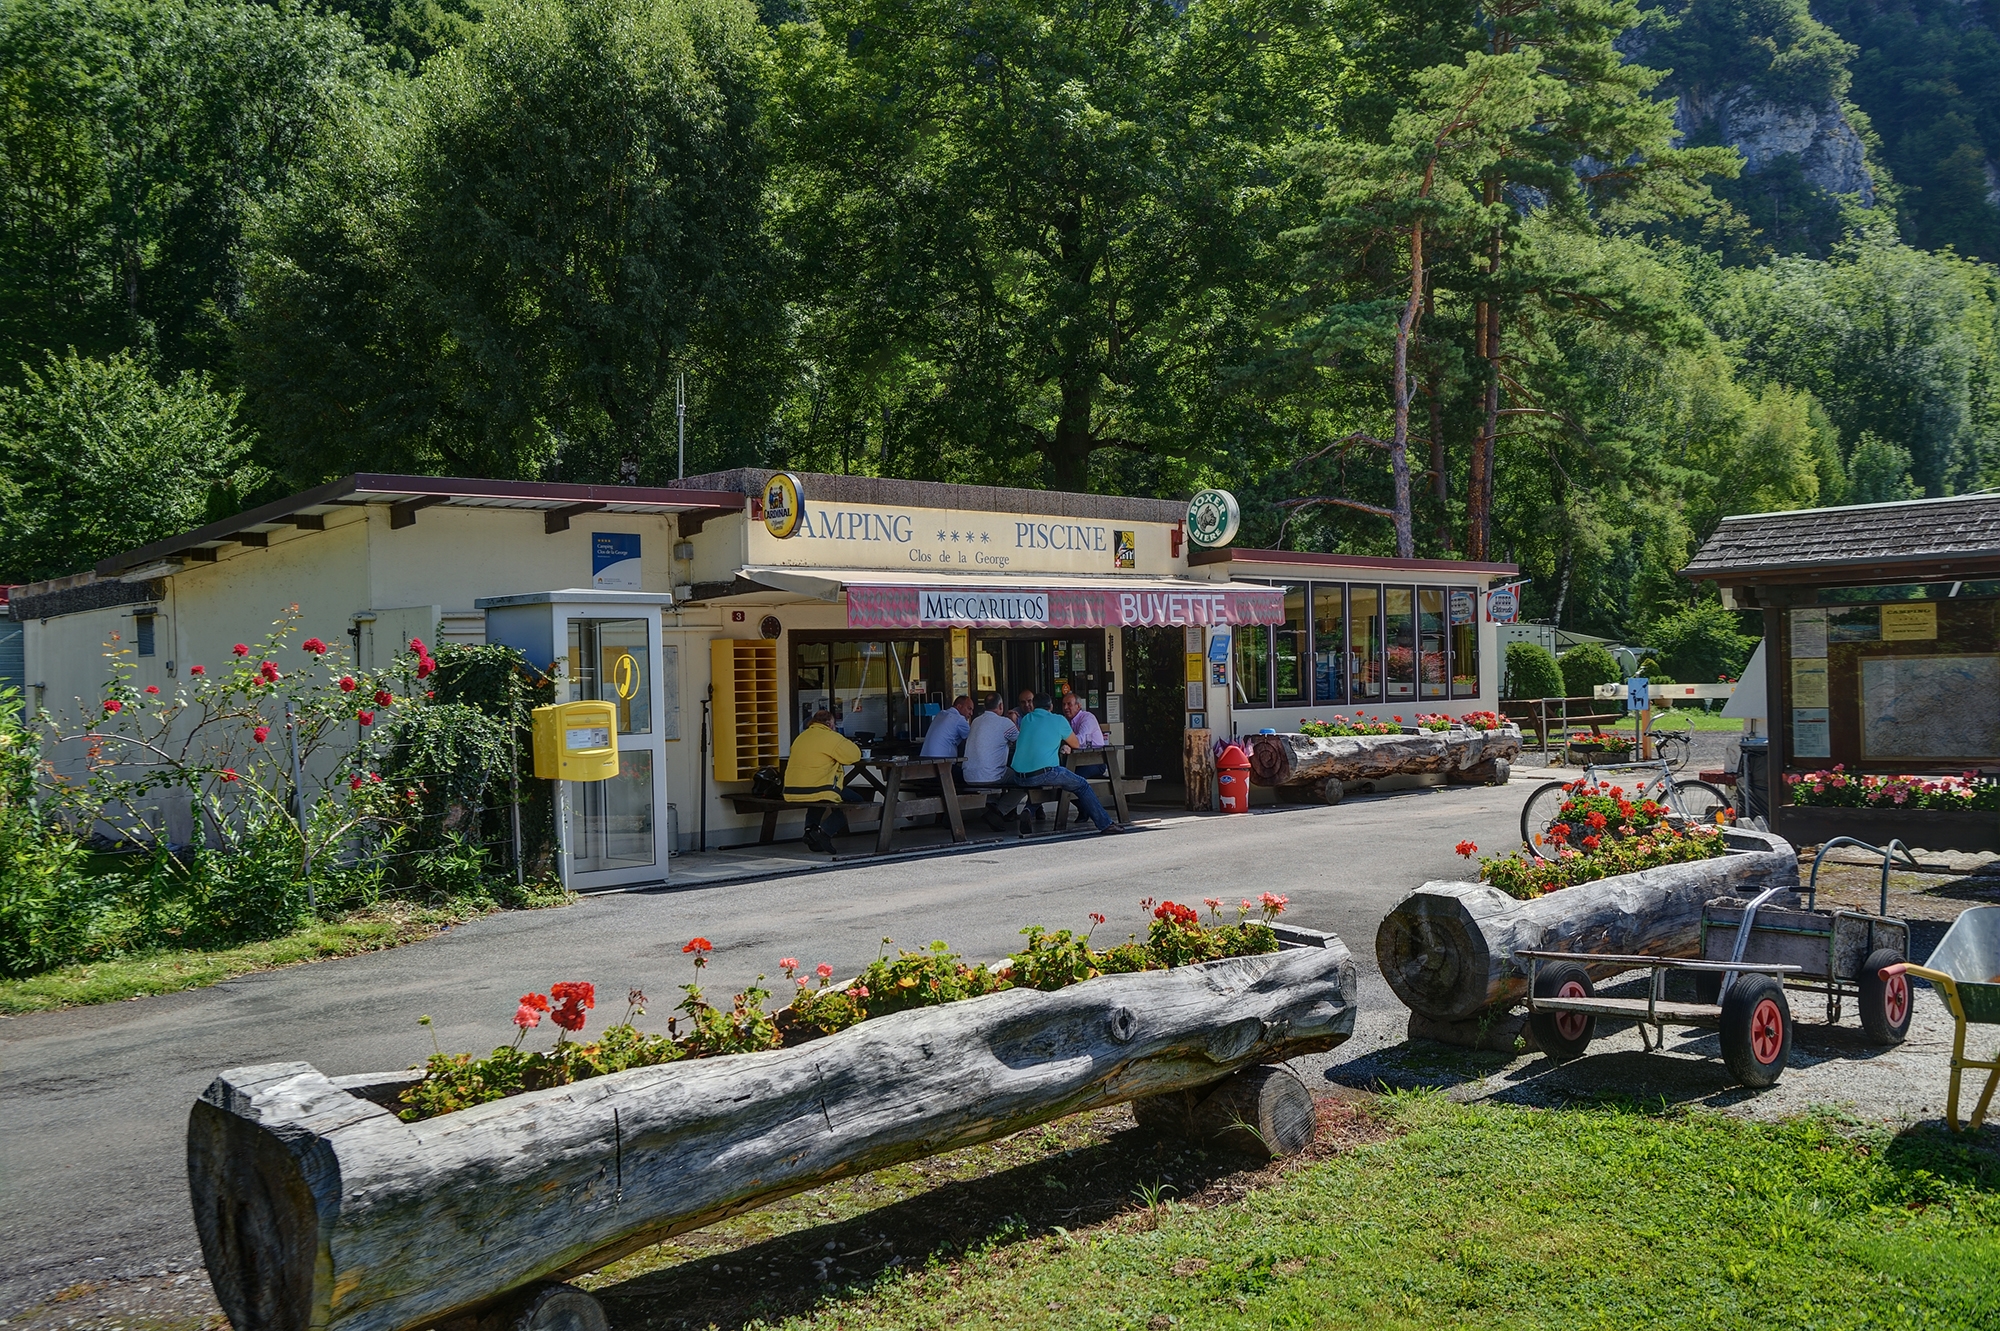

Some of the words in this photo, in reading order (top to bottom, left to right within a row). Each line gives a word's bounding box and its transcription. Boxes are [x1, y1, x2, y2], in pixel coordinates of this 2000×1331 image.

[764, 508, 792, 520] CARDINAL
[1190, 493, 1226, 516] BOXER
[795, 510, 914, 543] AMPING
[1015, 522, 1107, 551] PISCINE
[1193, 528, 1222, 542] BIERE
[909, 548, 932, 562] Clos
[939, 550, 951, 563] de
[958, 551, 967, 563] la
[975, 551, 1010, 569] George
[736, 612, 742, 621] 3
[925, 593, 1044, 621] MECCARILLOS
[1120, 593, 1226, 623] BUVETTE
